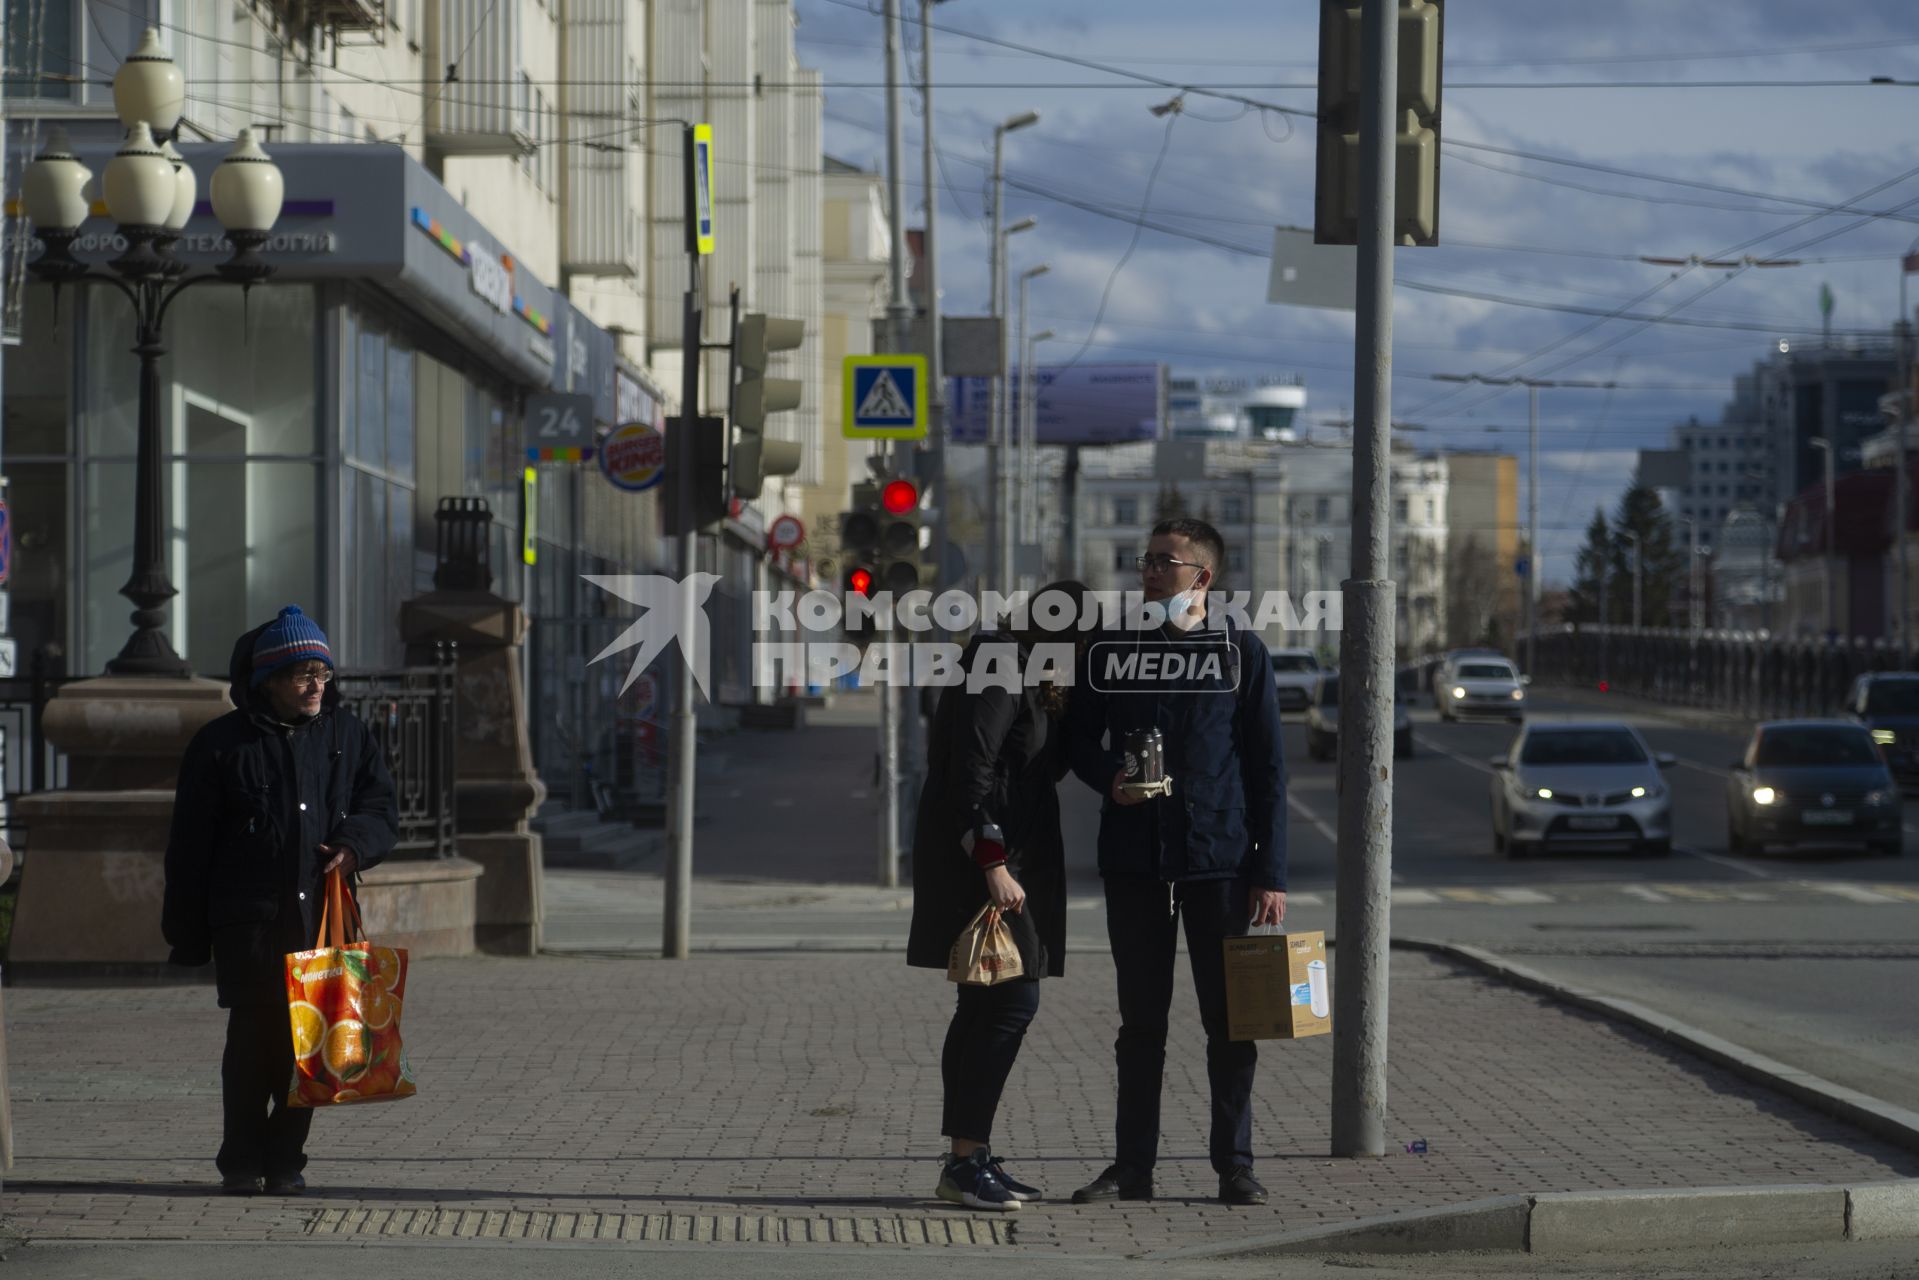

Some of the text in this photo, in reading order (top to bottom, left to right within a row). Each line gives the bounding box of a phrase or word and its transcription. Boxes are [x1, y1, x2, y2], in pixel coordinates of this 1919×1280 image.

[539, 406, 581, 438] 24
[607, 435, 662, 455] BURGER
[607, 448, 664, 477] KING
